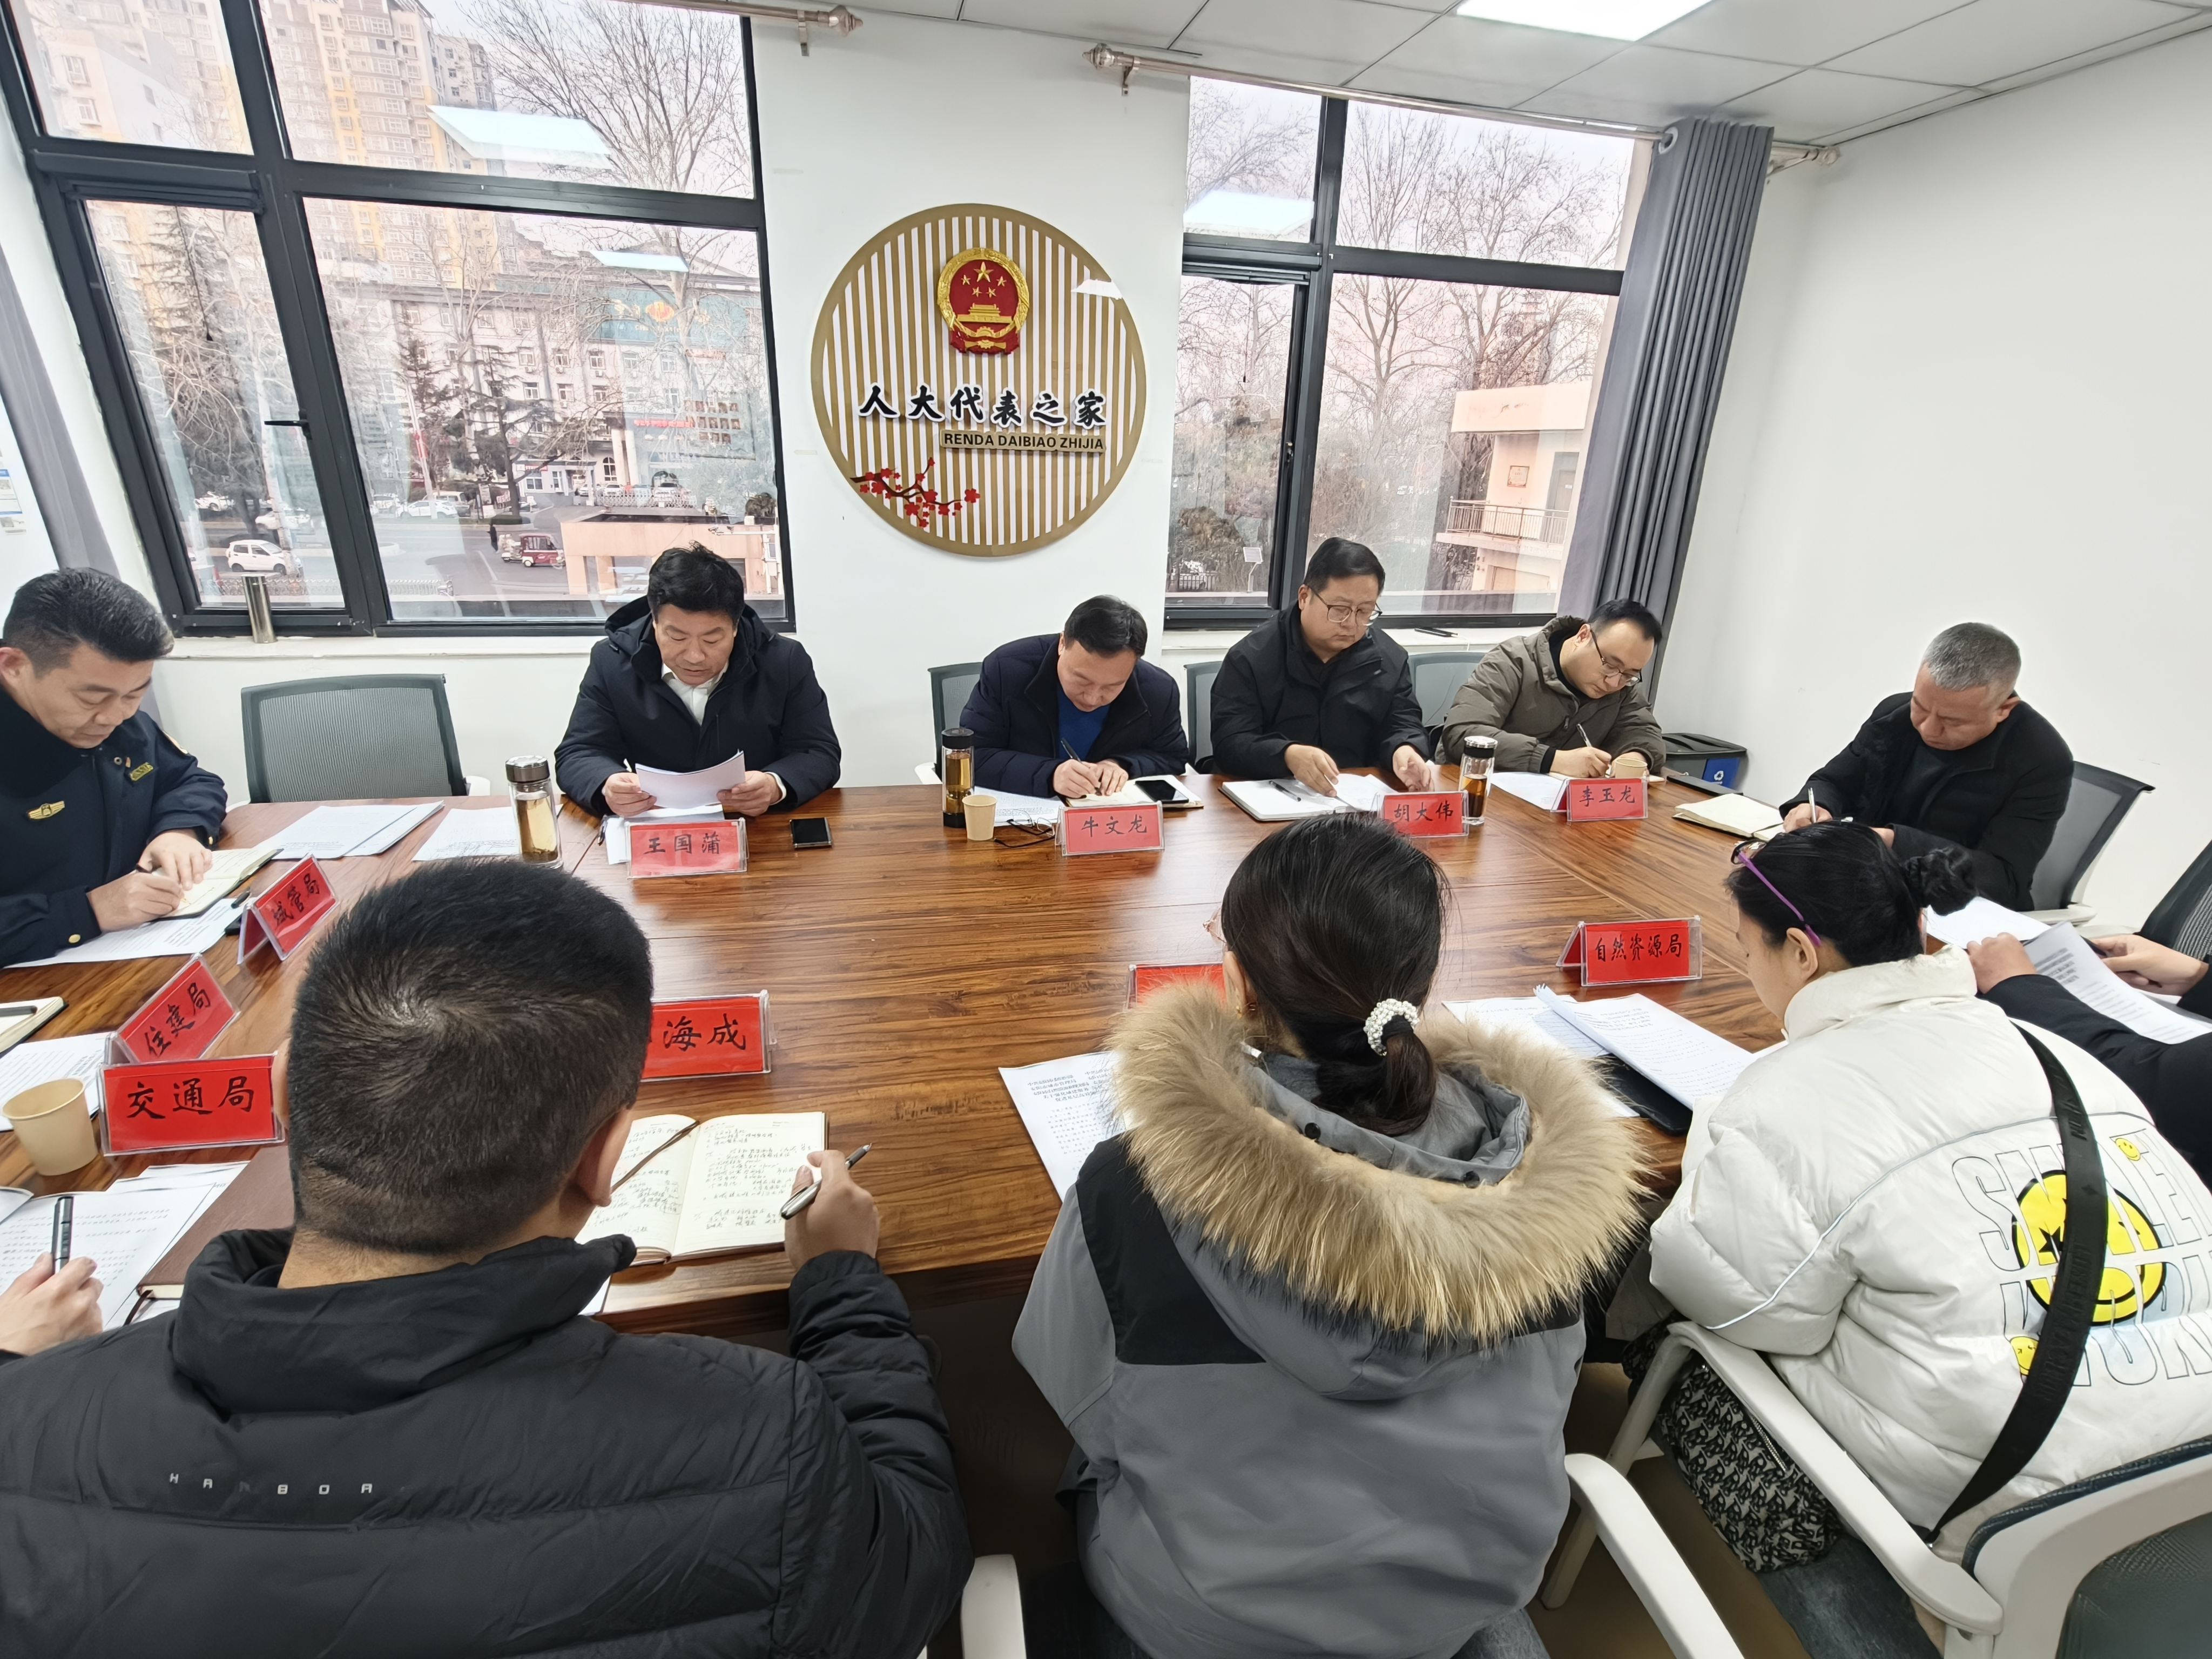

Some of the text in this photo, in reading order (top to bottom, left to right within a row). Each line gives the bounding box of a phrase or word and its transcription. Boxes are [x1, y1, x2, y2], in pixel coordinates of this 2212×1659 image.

[859, 384, 1106, 428] 人大代表之家
[944, 433, 1103, 449] RENDA DAIBIAO ZHIJIA
[1579, 785, 1635, 807] 李玉龙
[1393, 799, 1454, 822] 胡大伟
[1081, 814, 1147, 838] 牛文龙
[643, 831, 720, 854] 王国蒲
[1595, 933, 1682, 962] 自然资源局
[144, 982, 211, 1058] 住建局
[649, 1013, 746, 1052] 海成
[126, 1075, 255, 1119] 交通局
